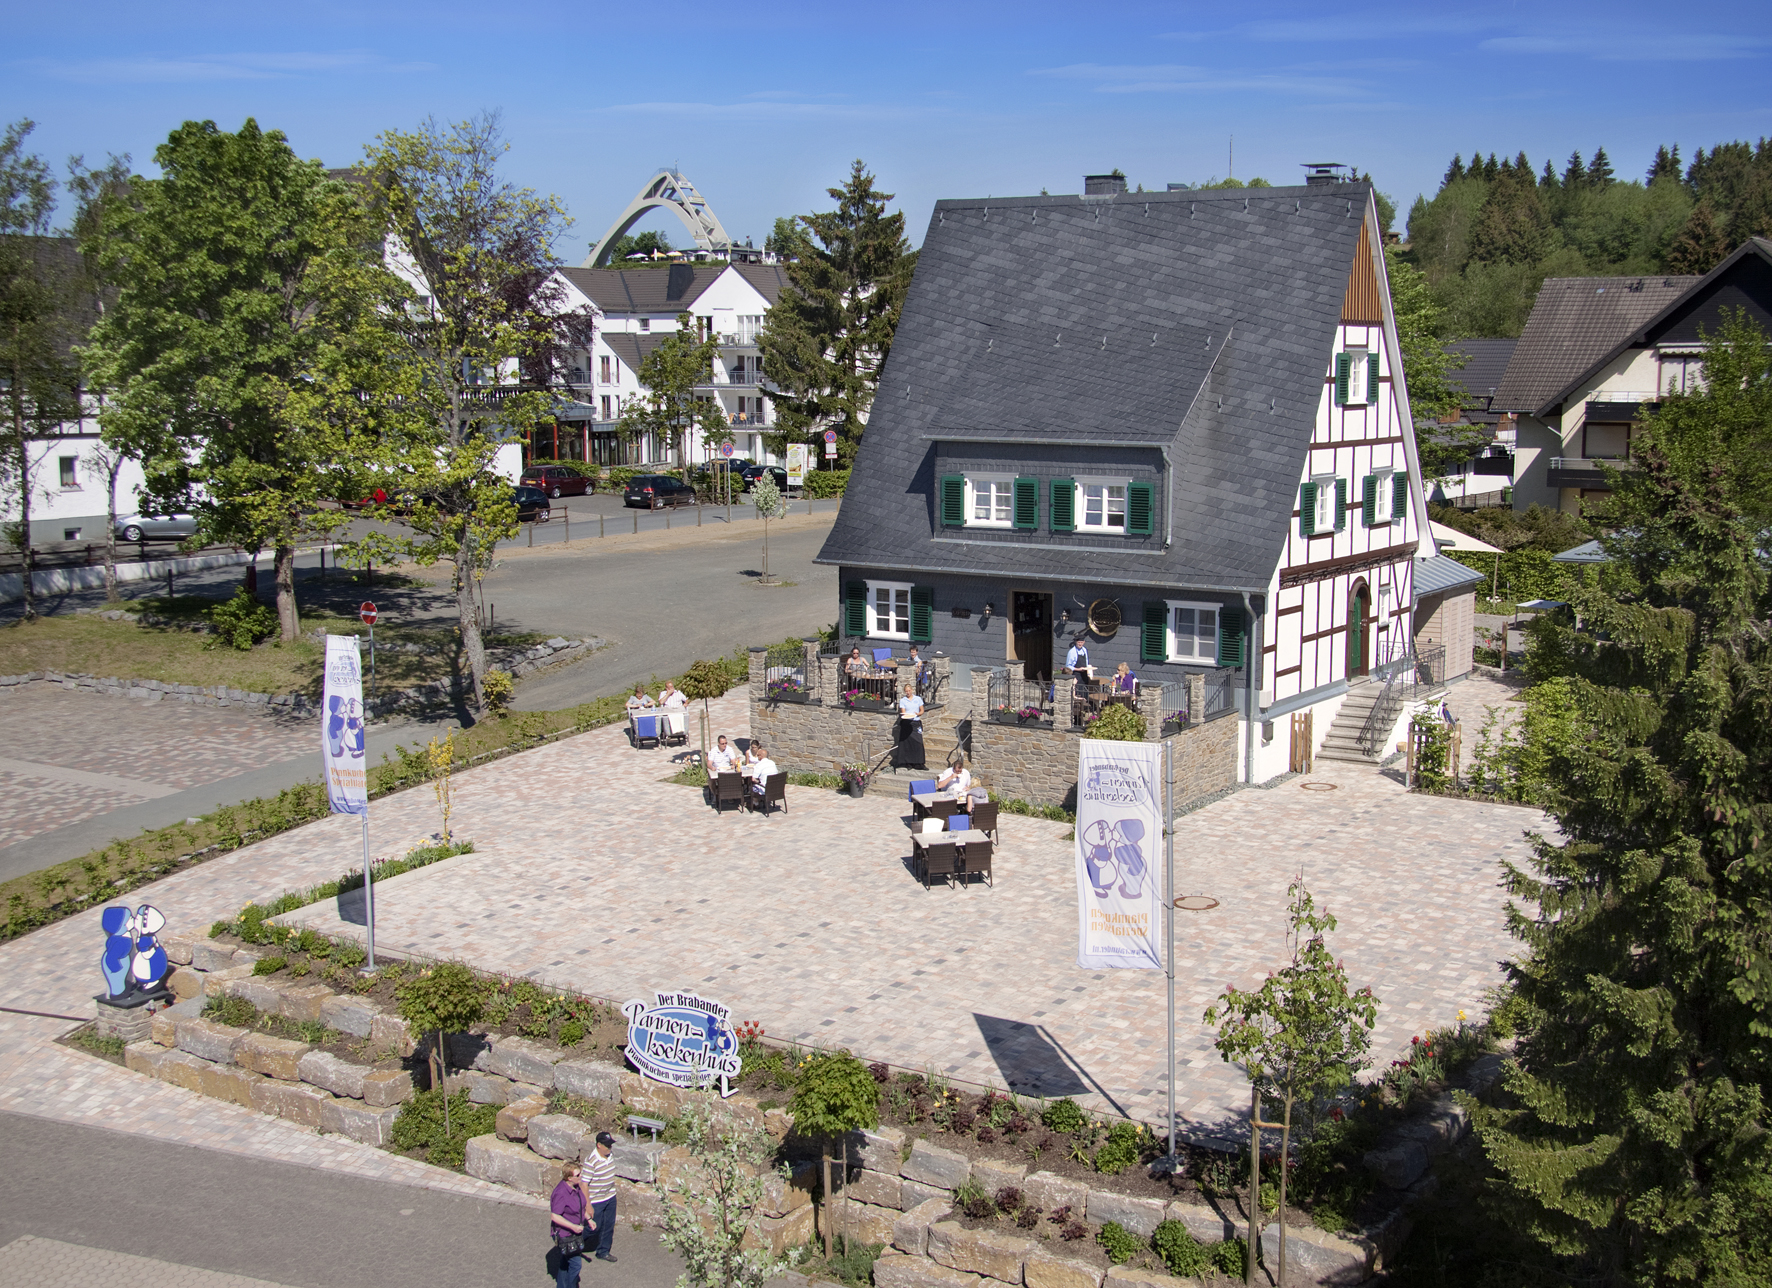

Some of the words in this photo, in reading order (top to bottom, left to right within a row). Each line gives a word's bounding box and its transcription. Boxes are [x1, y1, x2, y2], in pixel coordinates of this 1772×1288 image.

[625, 1003, 703, 1038] Pannen-
[658, 994, 675, 1006] Der
[677, 993, 729, 1019] Brabander
[646, 1032, 738, 1073] koekenhuis
